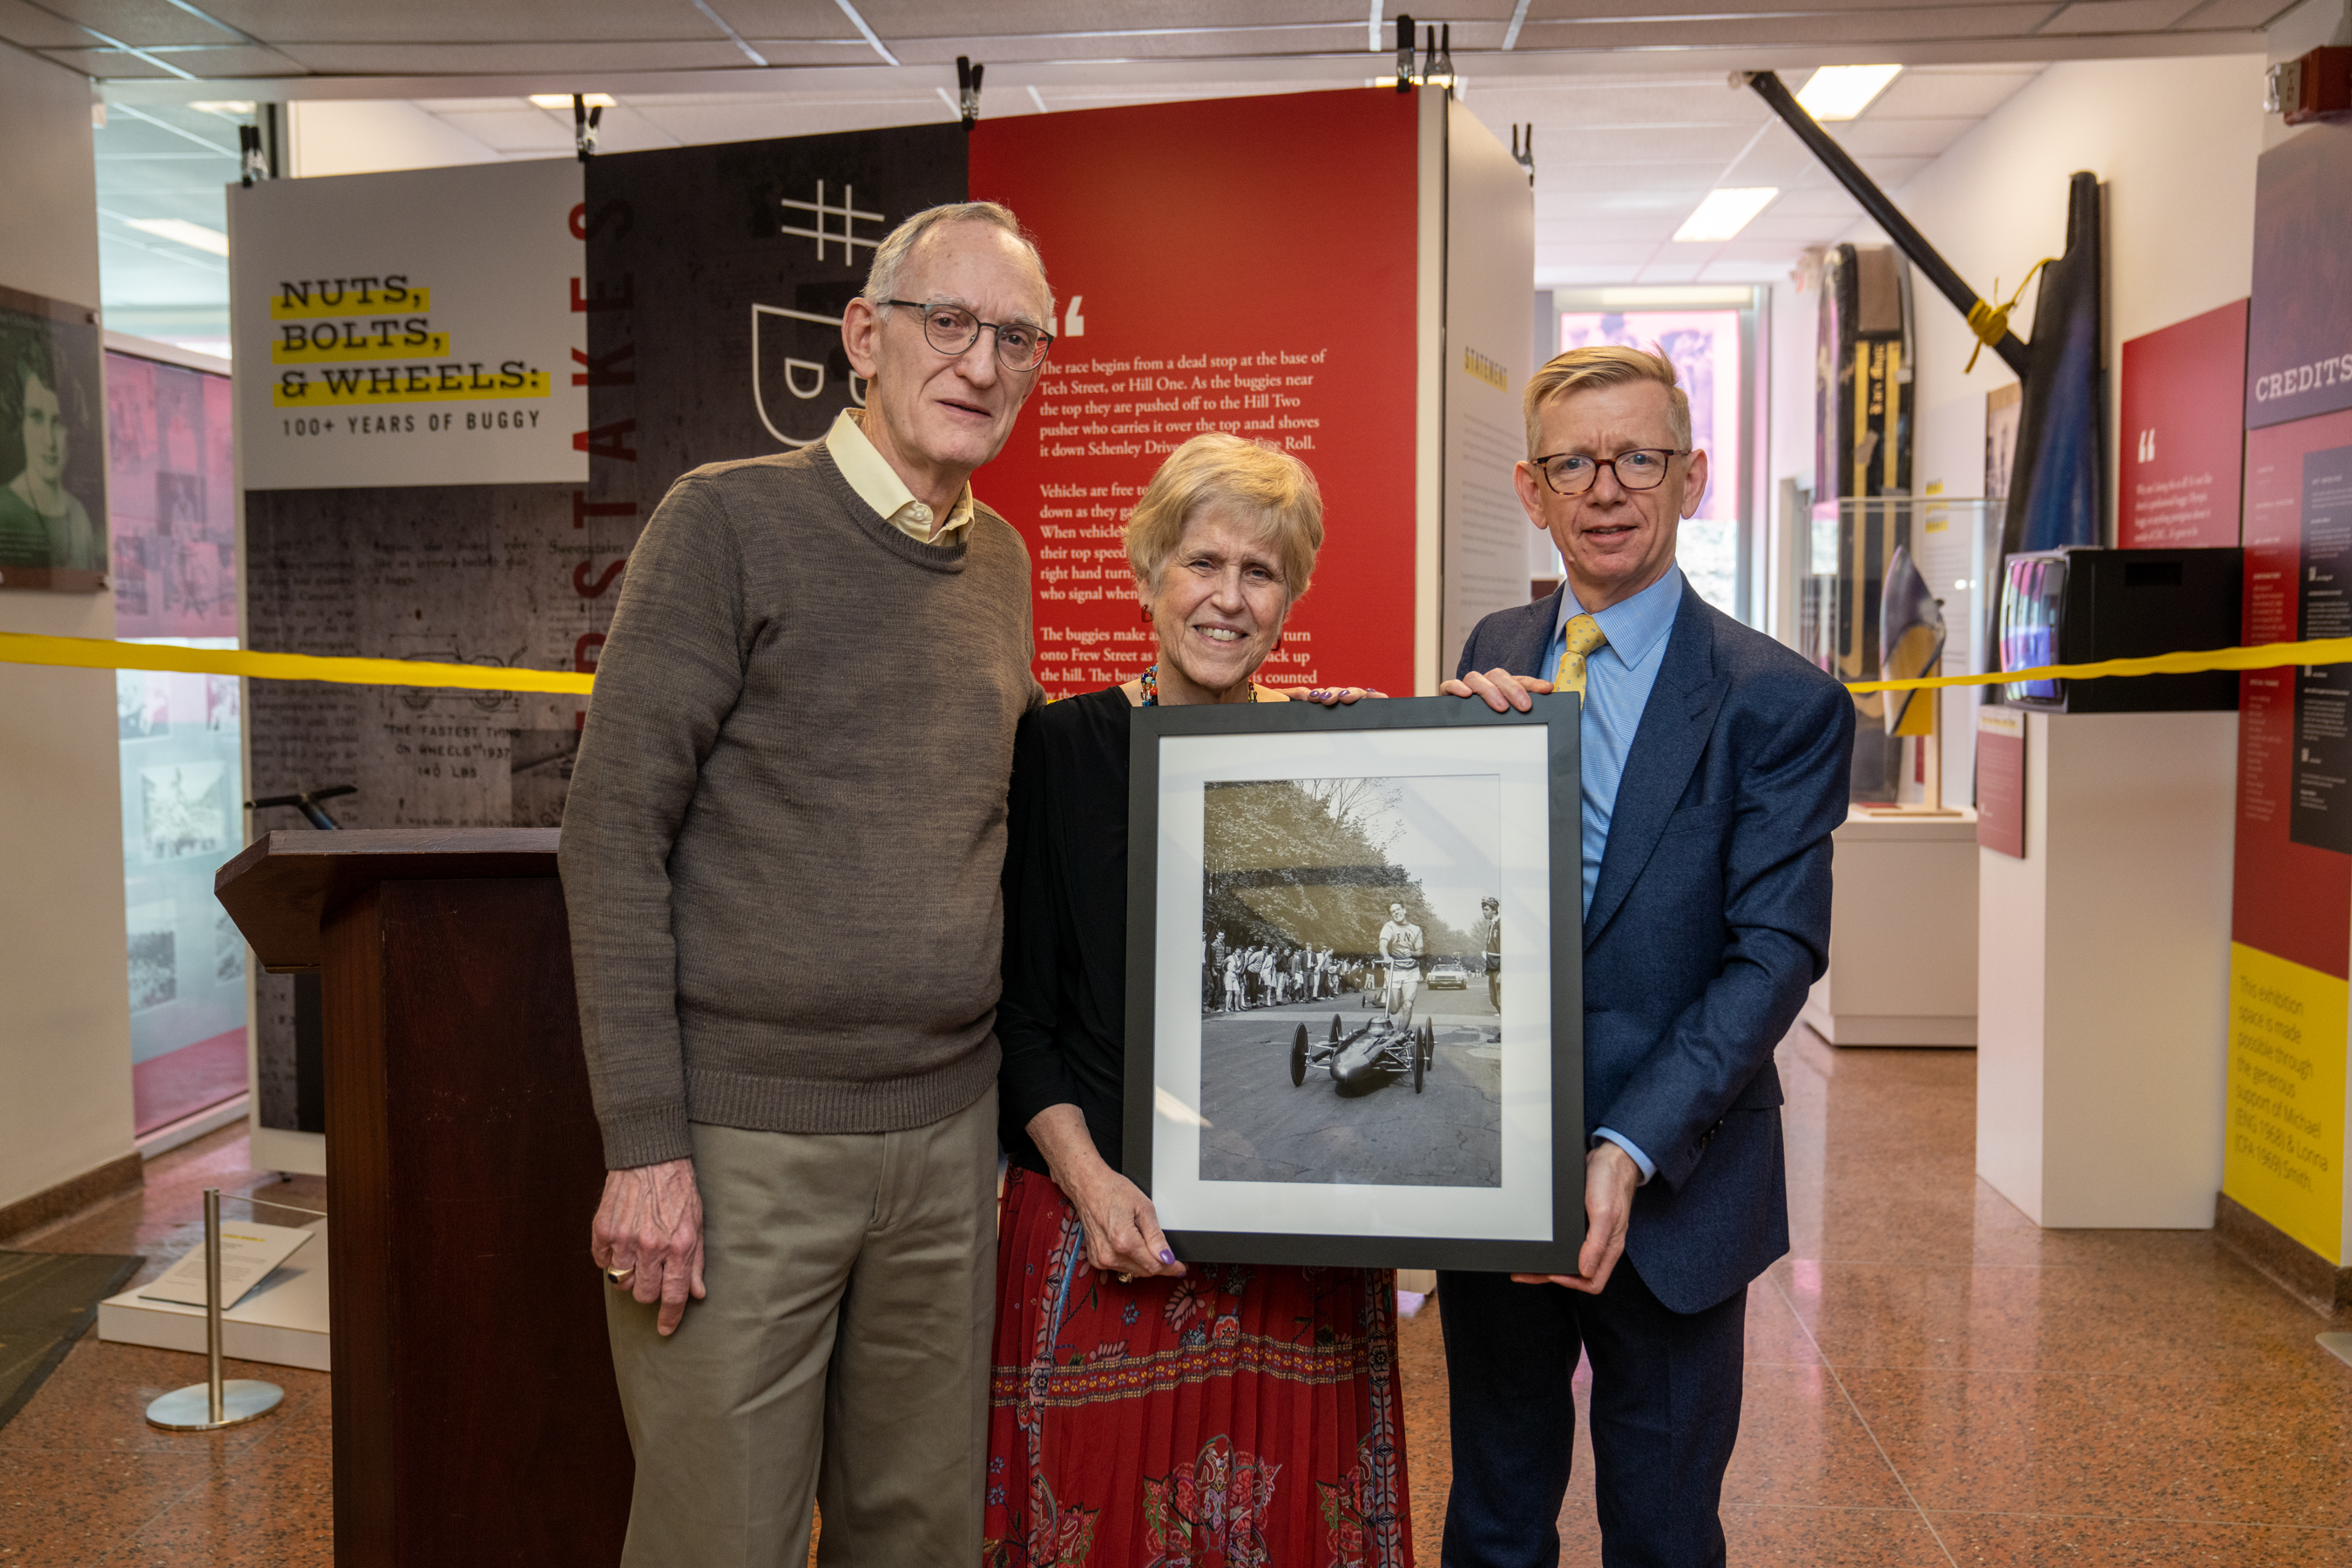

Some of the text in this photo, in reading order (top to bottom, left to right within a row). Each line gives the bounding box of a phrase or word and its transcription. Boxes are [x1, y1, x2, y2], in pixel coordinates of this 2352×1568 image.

[280, 274, 423, 308] NUTS,
[281, 317, 443, 352] BOLTS,
[1042, 348, 1328, 376] The race begins from a dead stop at the base of
[280, 361, 539, 399] & WHEELS:
[1038, 373, 1314, 395] Tech Street, or Hill One. As the buggies near
[2255, 353, 2352, 403] CREDITS
[1039, 393, 1301, 419] the top they are pushed off to the Hill Two
[283, 409, 540, 436] 100+ YEARS OF BUGGY
[1039, 414, 1320, 441] pusher who carries it over the top anad shoves
[1040, 443, 1049, 457] it
[1051, 443, 1085, 457] down
[1088, 440, 1141, 458] Schenley
[1285, 435, 1316, 449] Roll.
[1039, 481, 1148, 498] Vehicles are free to
[1039, 504, 1072, 518] down
[1076, 508, 1088, 518] as
[1091, 503, 1118, 521] they
[1039, 524, 1076, 538] When
[1040, 544, 1127, 563] their top speed
[1040, 565, 1135, 584] right hand turn.
[1039, 585, 1139, 605] who signal when
[1040, 626, 1063, 641] The
[1065, 626, 1111, 645] buggies
[1113, 626, 1146, 641] make
[1283, 632, 1311, 641] turn
[1040, 651, 1068, 661] onto
[1071, 647, 1101, 661] Frew
[1103, 647, 1138, 661] Street
[1140, 652, 1153, 662] as
[1293, 652, 1310, 667] up
[1040, 666, 1059, 681] the
[1063, 667, 1085, 681] hill.
[1088, 667, 1112, 682] The
[1253, 672, 1263, 684] is
[1265, 669, 1317, 684] counted
[420, 725, 478, 738] FASTEST
[2258, 986, 2304, 1017] exhibition
[2239, 1005, 2264, 1029] space
[2274, 1021, 2301, 1044] made
[2237, 1031, 2314, 1080] possible through
[2237, 1056, 2295, 1098] the generous
[2236, 1085, 2270, 1114] support
[2283, 1105, 2322, 1139] Michael
